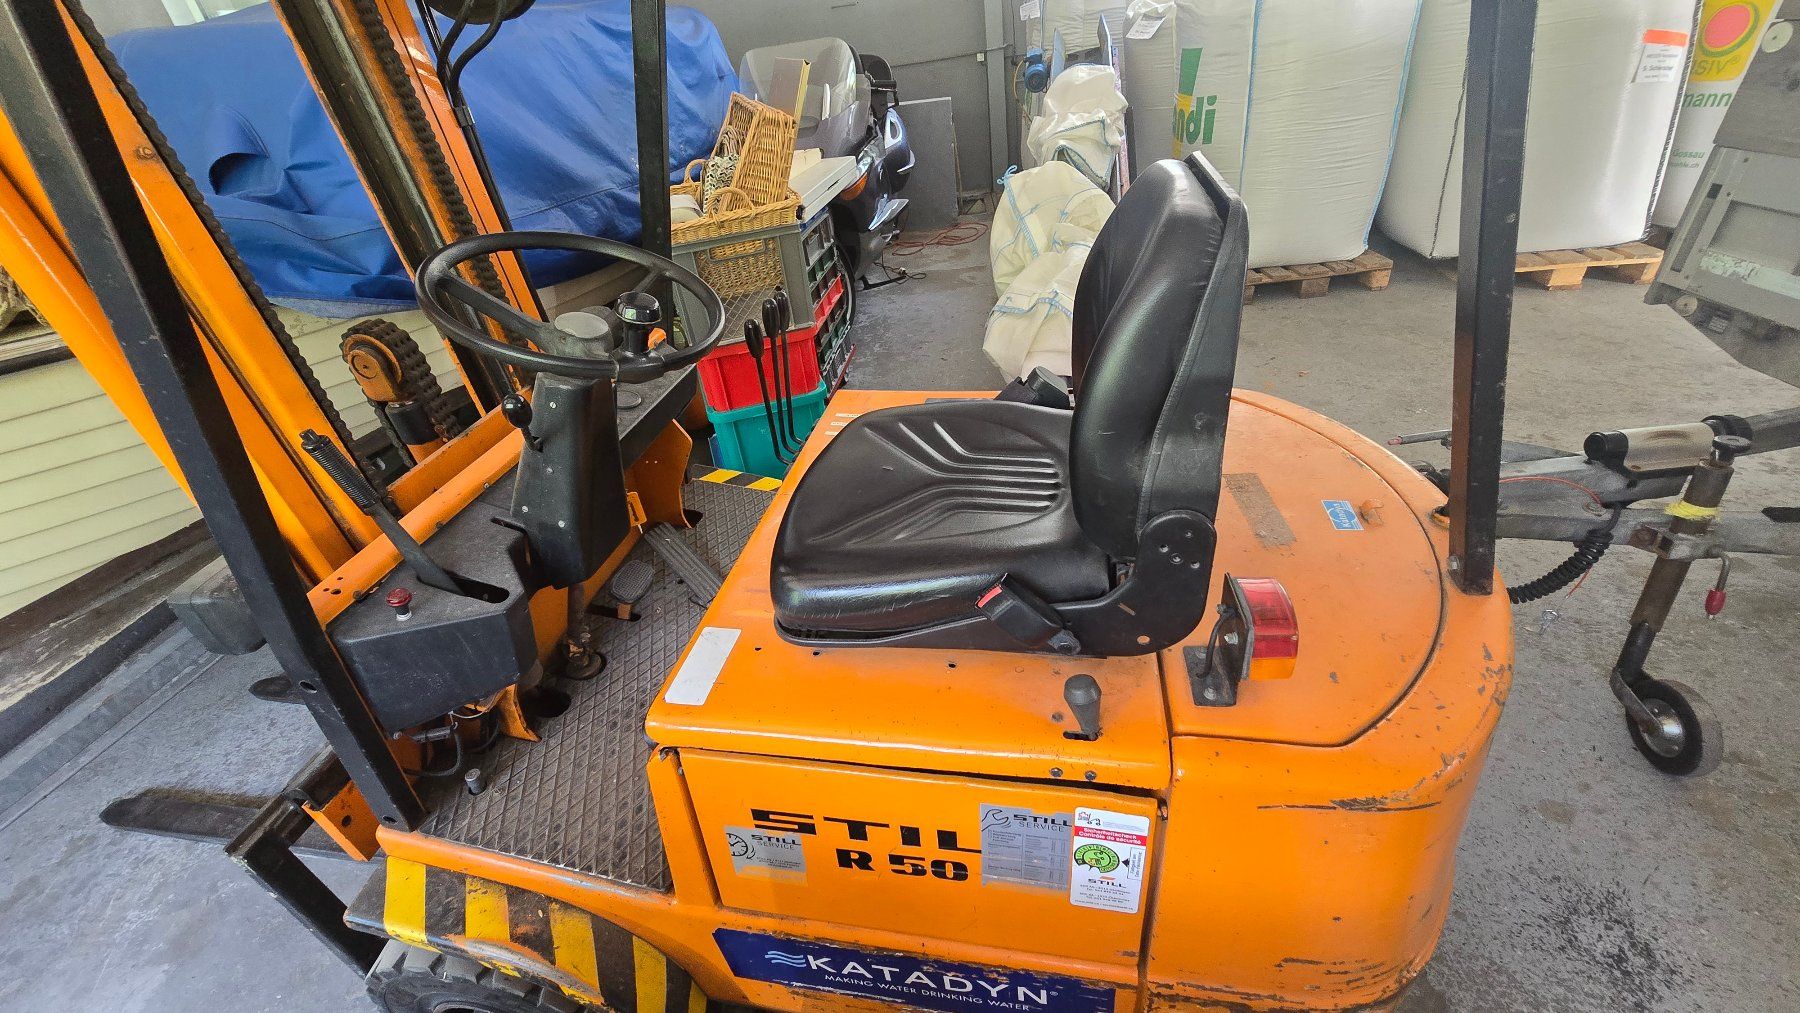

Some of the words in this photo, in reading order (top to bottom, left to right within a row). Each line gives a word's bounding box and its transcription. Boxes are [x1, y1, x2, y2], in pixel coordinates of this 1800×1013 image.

[1172, 95, 1217, 145] ndi
[1013, 814, 1072, 828] STILL
[1018, 821, 1065, 832] SERVICE
[751, 834, 802, 846] STILL
[1078, 831, 1105, 840] Contrôle
[757, 841, 795, 850] SERVICE
[835, 847, 876, 872] R
[888, 853, 969, 882] 50
[1087, 878, 1127, 889] STILL
[806, 955, 1048, 1005] KATADYN
[824, 974, 873, 987] MAKING
[877, 983, 917, 994] WATER
[921, 989, 983, 1005] DRINKING
[987, 1000, 1030, 1011] WATER
